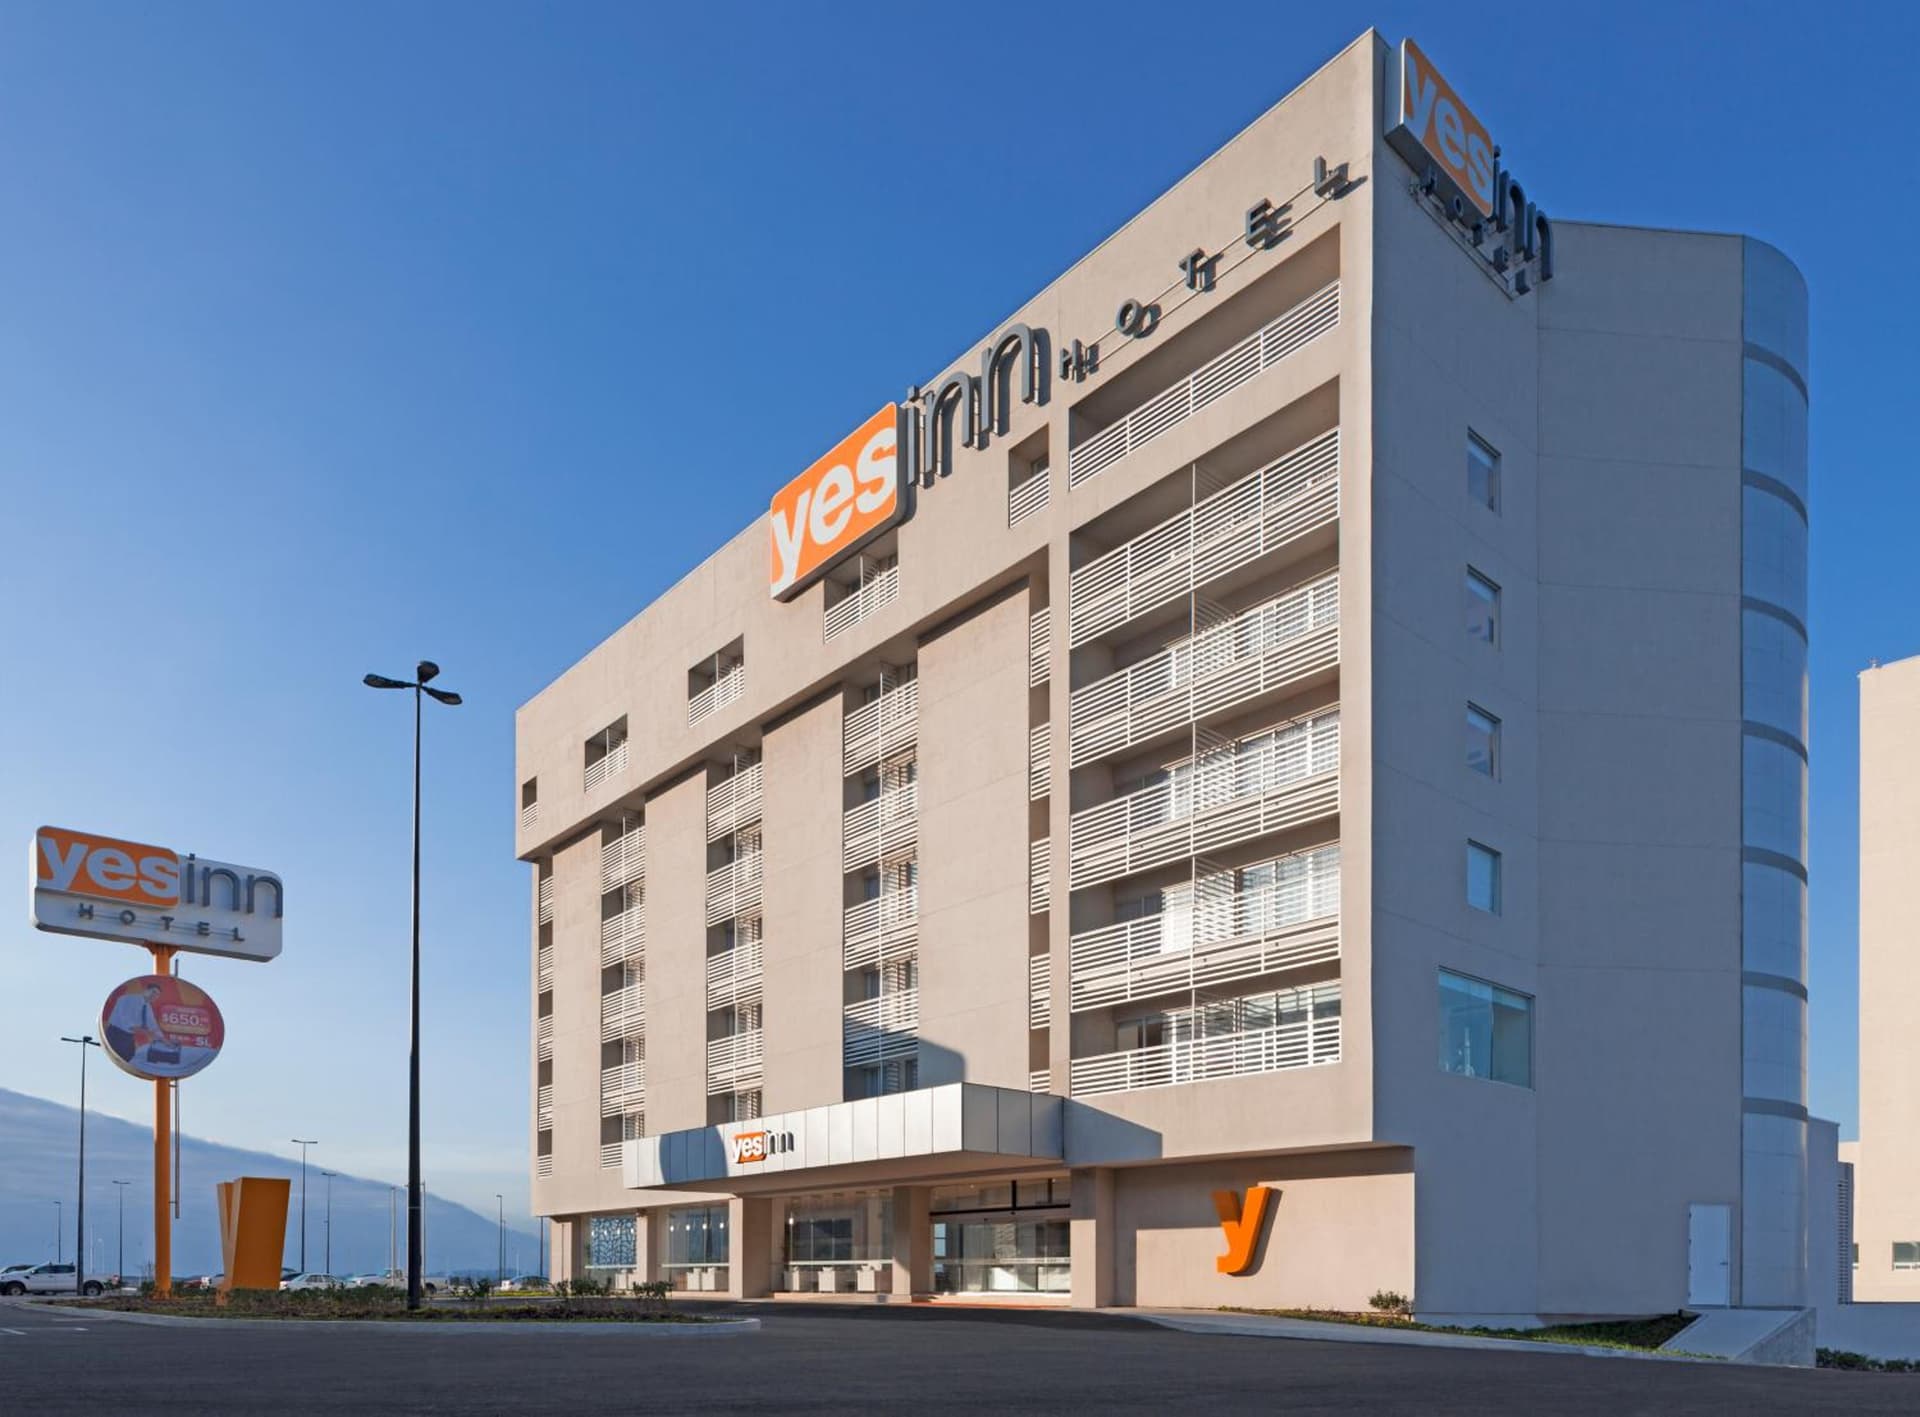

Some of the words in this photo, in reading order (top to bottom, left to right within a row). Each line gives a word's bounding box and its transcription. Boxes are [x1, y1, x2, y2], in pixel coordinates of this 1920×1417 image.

[1405, 56, 1493, 208] yes
[1060, 155, 1348, 381] HOTEL
[770, 427, 897, 599] yes
[907, 323, 1032, 487] inn
[38, 837, 180, 899] yes
[187, 853, 283, 918] inn
[78, 903, 245, 942] HOTEL
[731, 1136, 764, 1163] yes
